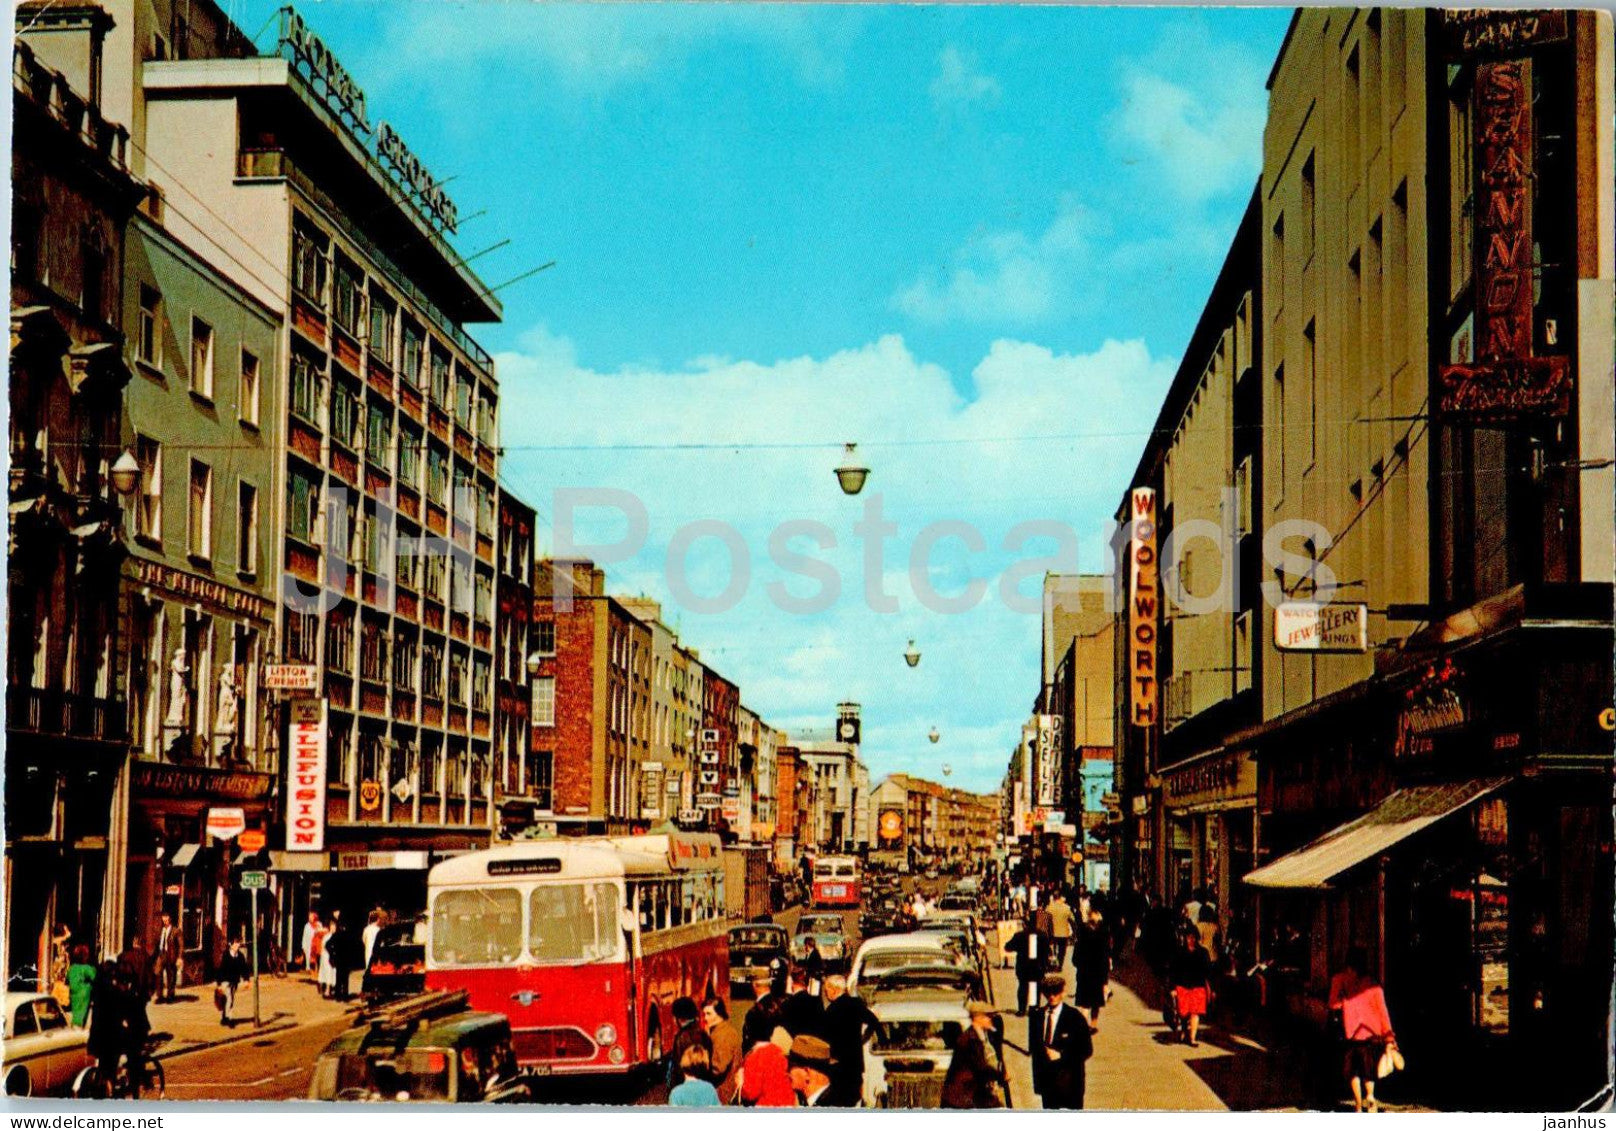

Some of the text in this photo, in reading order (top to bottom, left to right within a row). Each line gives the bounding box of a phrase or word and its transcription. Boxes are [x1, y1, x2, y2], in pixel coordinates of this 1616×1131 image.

[377, 120, 458, 235] GEORGE
[1480, 64, 1526, 352] SHANNON
[1135, 494, 1155, 722] WOOLWORTH
[1287, 608, 1360, 646] JEWELLERY
[266, 675, 310, 688] CHEMIST
[270, 665, 307, 676] LISTON
[294, 704, 319, 844] TELEFUSION
[1041, 729, 1050, 798] SELF
[1052, 716, 1062, 804] DRIVE
[244, 873, 266, 885] bus
